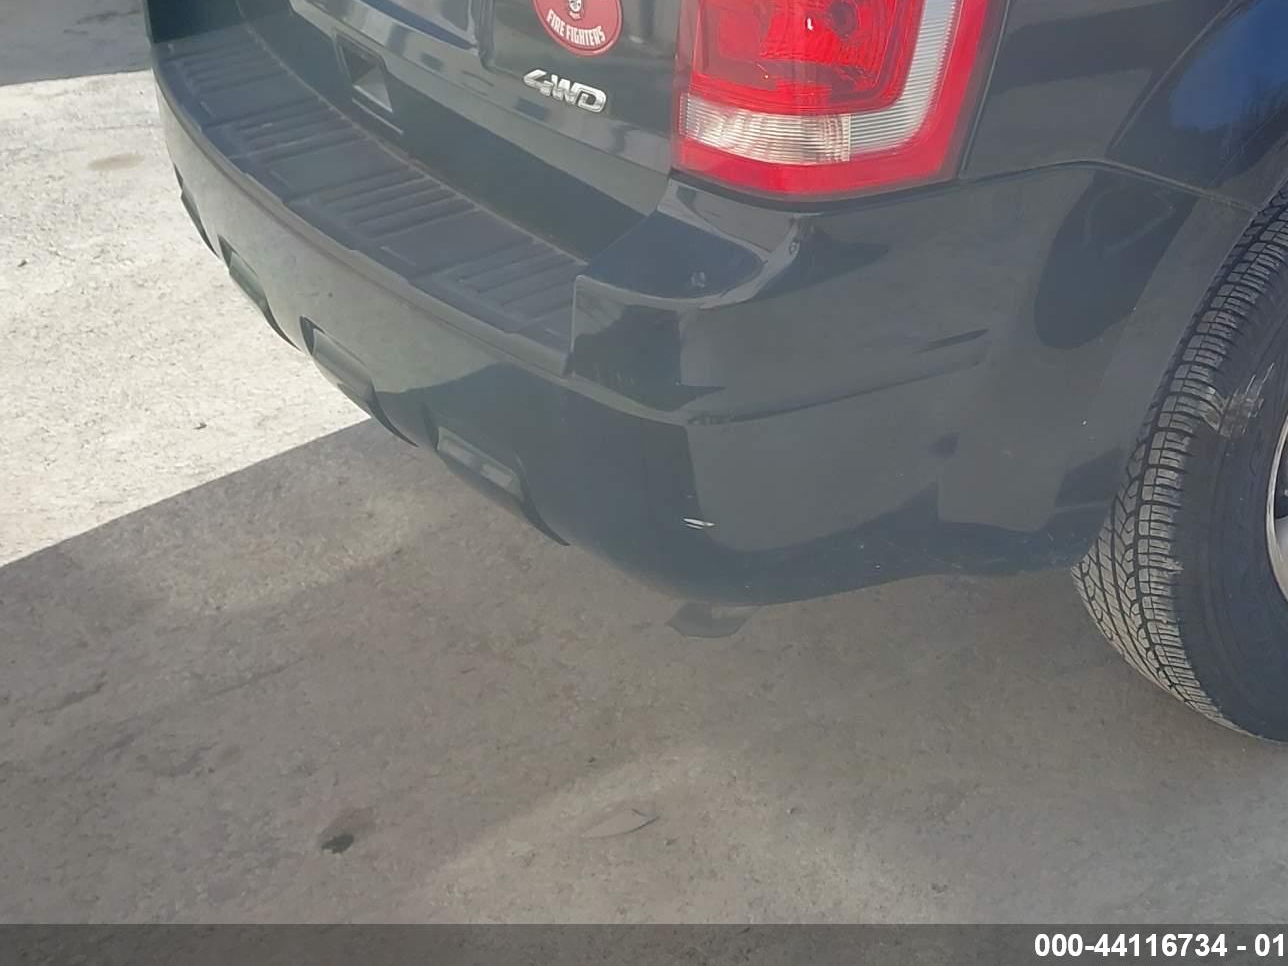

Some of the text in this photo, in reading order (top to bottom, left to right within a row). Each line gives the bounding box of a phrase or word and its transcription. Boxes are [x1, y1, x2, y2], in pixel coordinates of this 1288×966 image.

[546, 9, 606, 47] FIRE FIGHTERS
[523, 69, 607, 113] 4WD
